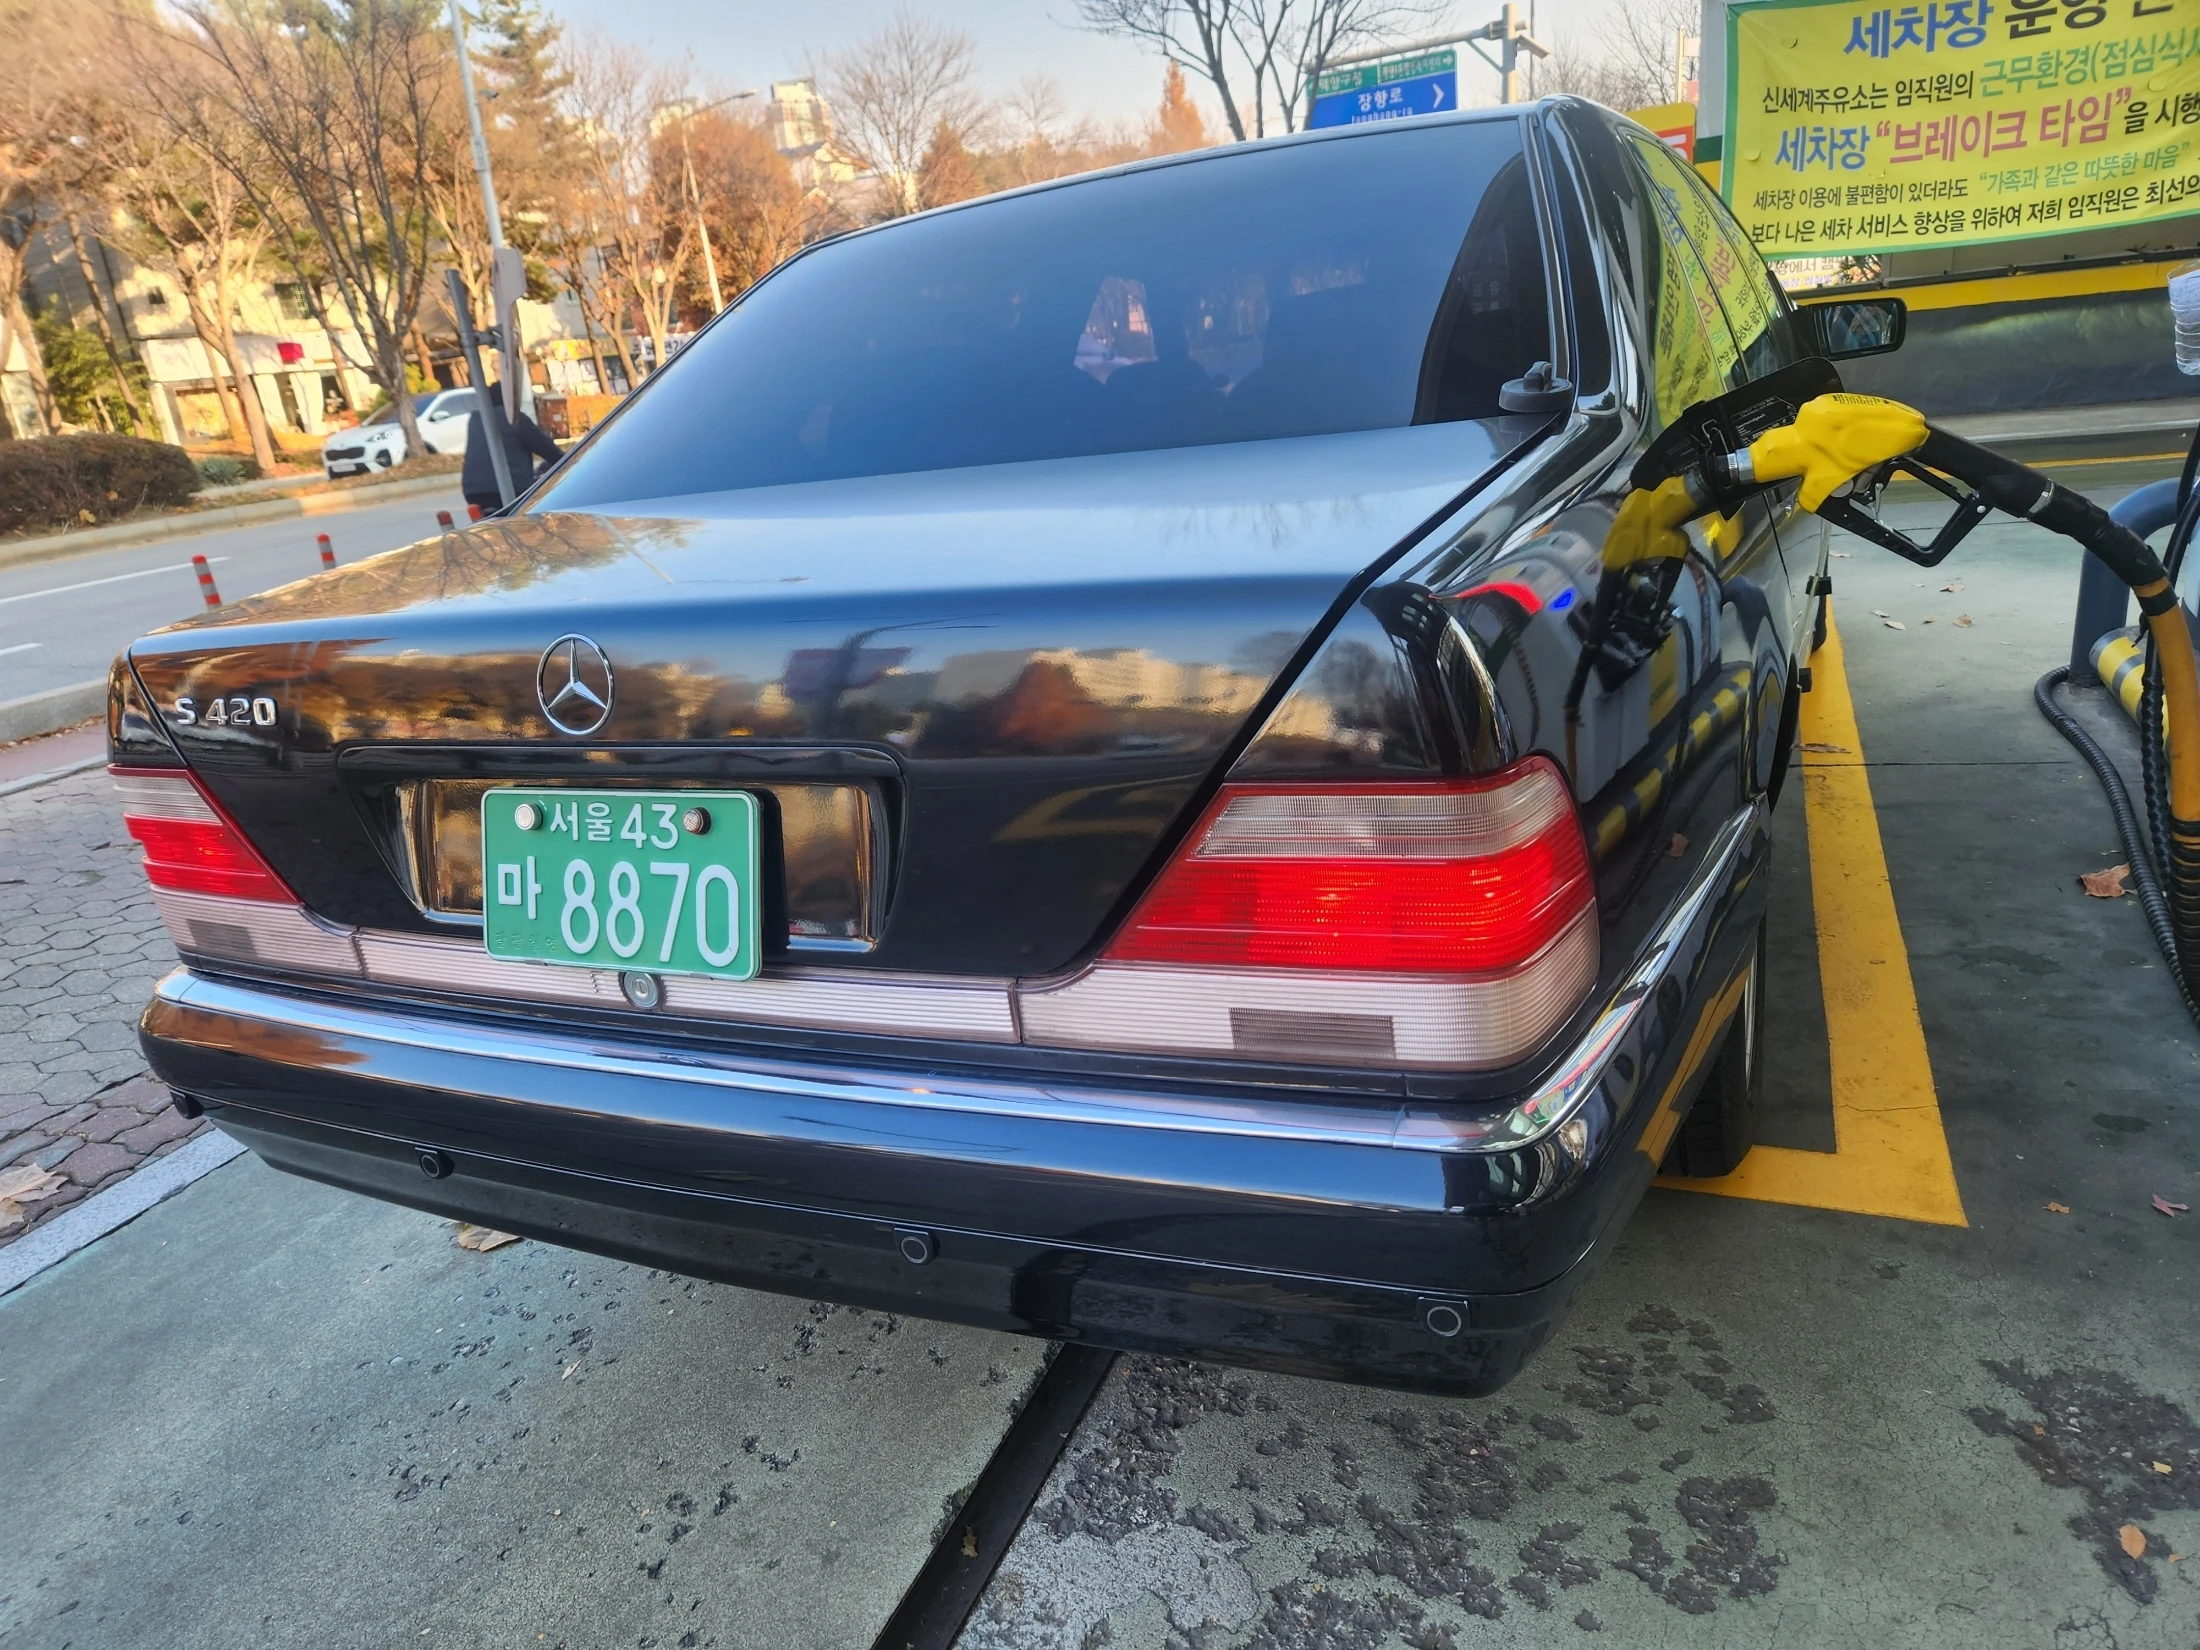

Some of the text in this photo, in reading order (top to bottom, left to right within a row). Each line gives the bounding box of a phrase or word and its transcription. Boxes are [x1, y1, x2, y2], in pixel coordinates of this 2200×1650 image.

[1843, 0, 1994, 58] 세차장
[1358, 87, 1404, 113] 장항로
[1762, 83, 1889, 114] 신세계주유소는
[1895, 70, 1974, 107] 임직원의
[1774, 125, 1871, 172] 세차장
[1753, 188, 1796, 211] 세차장
[1799, 186, 1842, 209] 이용에
[1845, 183, 1903, 206] 불편함이
[1908, 178, 1969, 203] 있더라도
[2044, 160, 2079, 189] 같은
[2084, 151, 2139, 182] 따뜻한
[1751, 221, 1781, 244] 보다
[1785, 218, 1816, 243] 나은
[1819, 215, 1853, 241] 세차
[1856, 213, 1909, 239] 서비스
[1913, 207, 1966, 236] 향상을
[1970, 203, 2022, 230] 위하여
[2026, 197, 2063, 224] 저희
[2067, 185, 2140, 219] 임직원은
[174, 697, 278, 727] S 420
[497, 856, 740, 968] 마 8870
